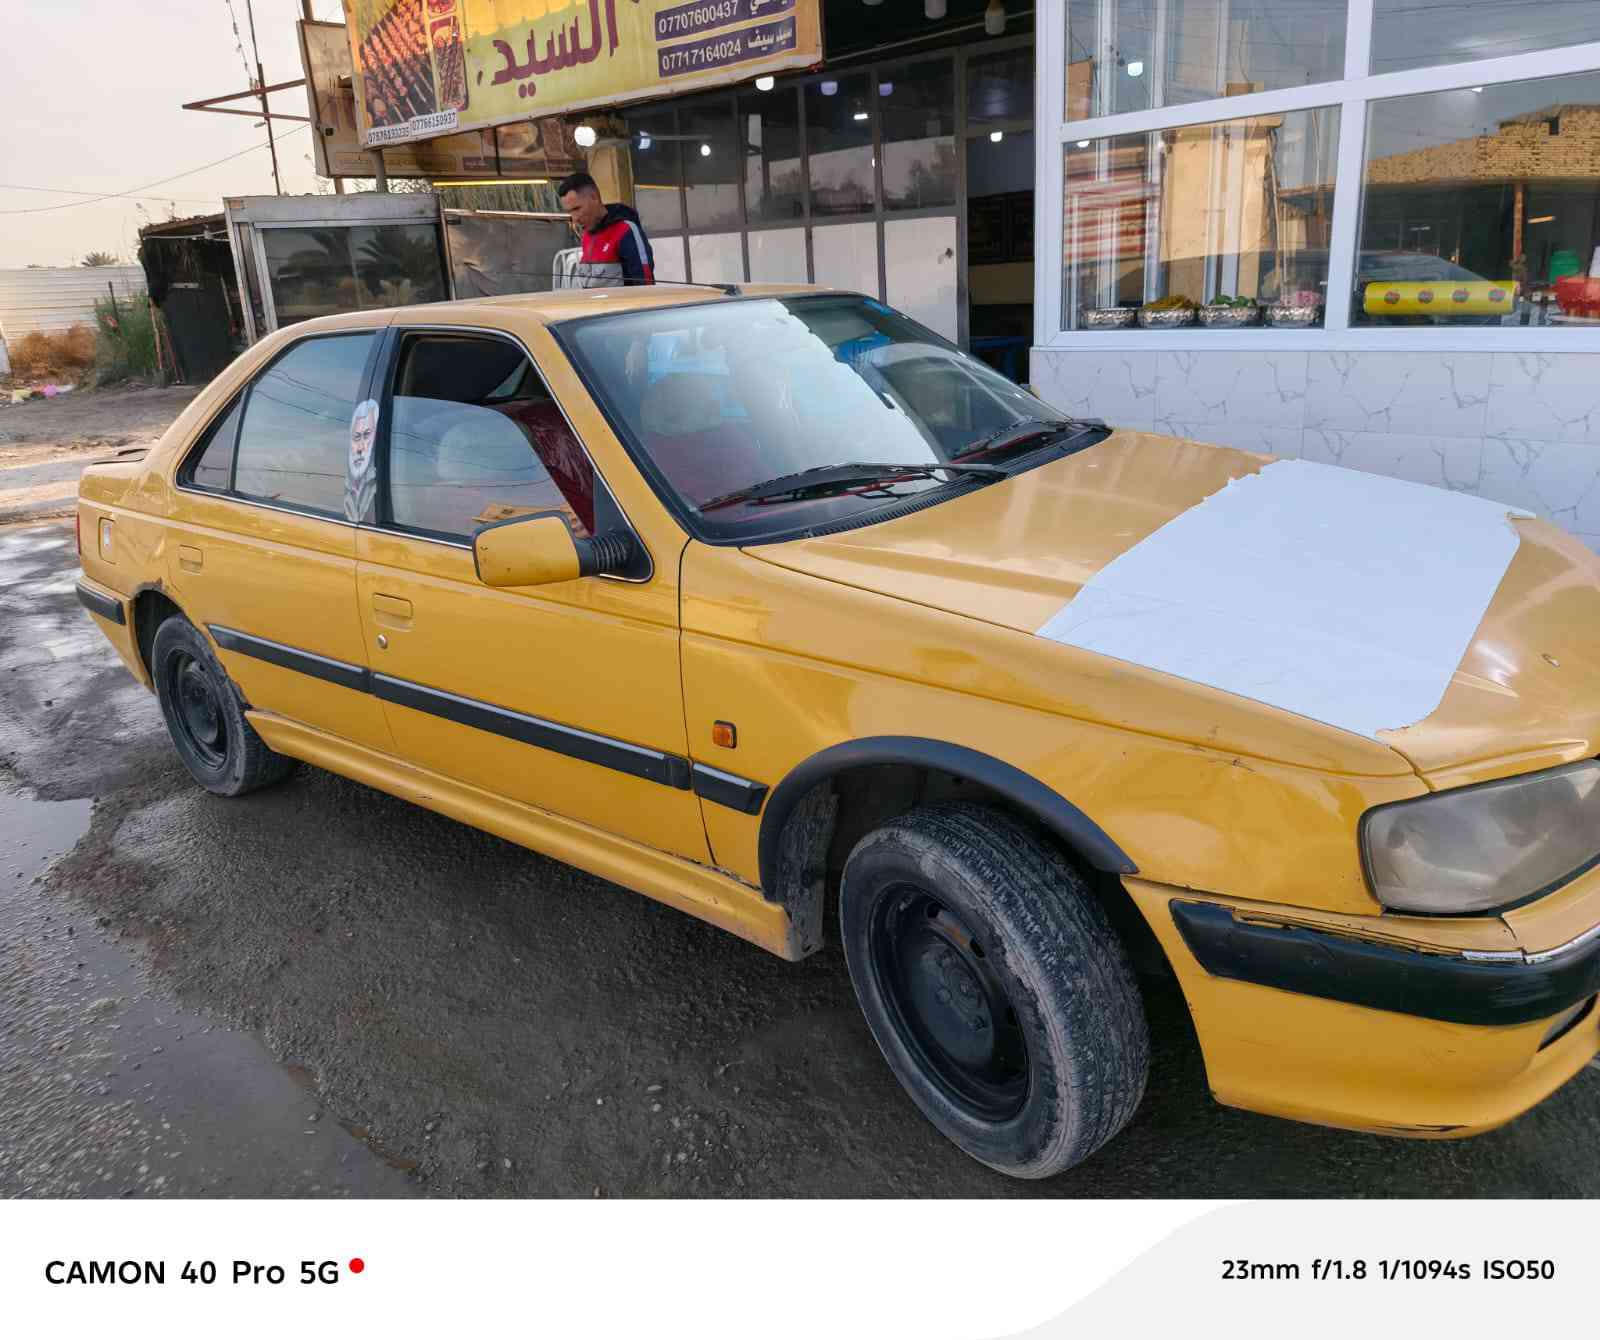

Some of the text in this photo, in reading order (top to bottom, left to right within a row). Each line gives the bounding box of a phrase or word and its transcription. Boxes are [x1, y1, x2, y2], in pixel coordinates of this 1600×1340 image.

[658, 1, 739, 34] 07707600437
[491, 0, 619, 98] السيد
[662, 38, 742, 71] 07717164024
